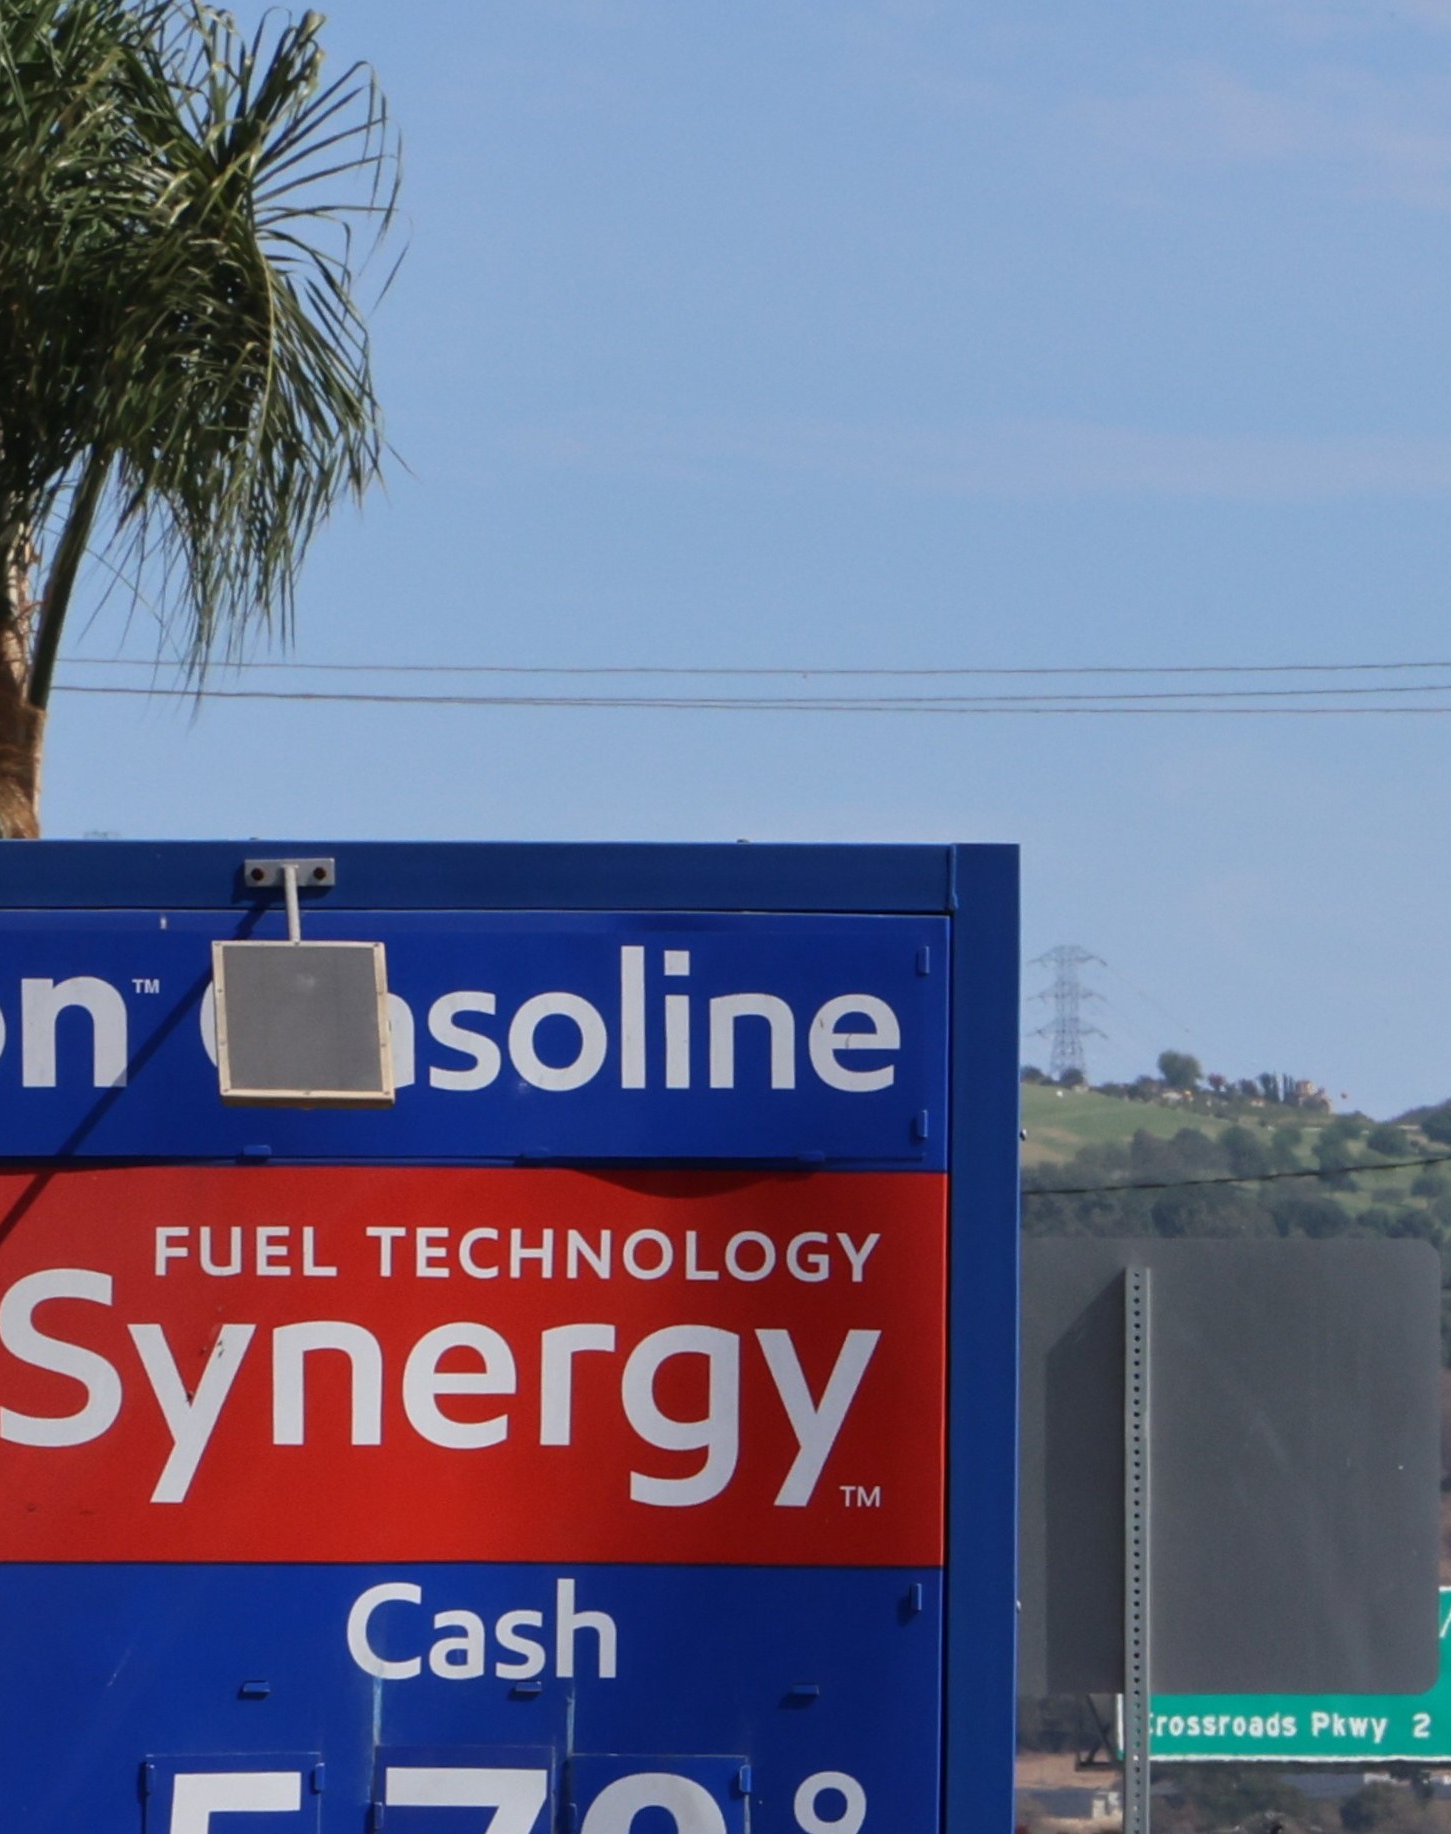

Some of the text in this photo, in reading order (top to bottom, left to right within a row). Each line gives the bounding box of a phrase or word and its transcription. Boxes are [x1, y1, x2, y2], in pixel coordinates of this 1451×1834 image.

[200, 945, 901, 1092] soline
[154, 1225, 880, 1283] FUEL TECHNOLOGY
[346, 1578, 617, 1680] Cash
[1149, 1711, 1431, 1744] rossroads Pkwy 2
